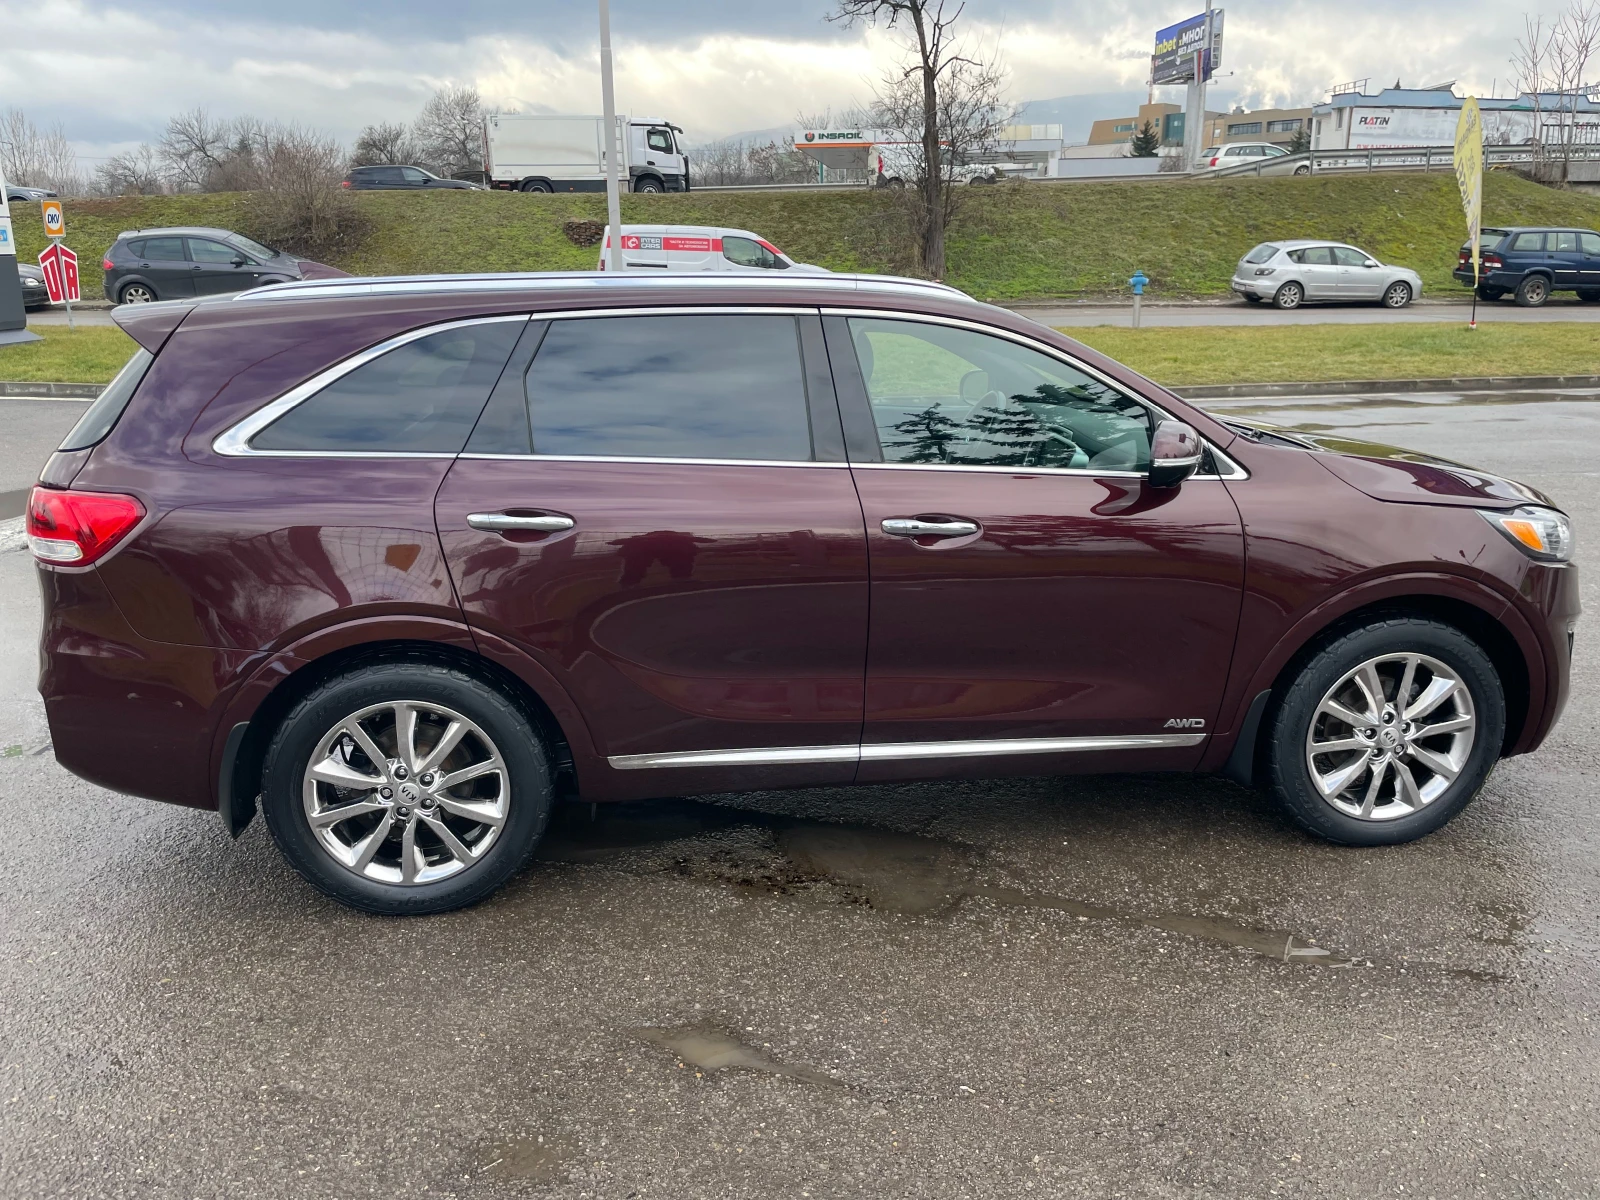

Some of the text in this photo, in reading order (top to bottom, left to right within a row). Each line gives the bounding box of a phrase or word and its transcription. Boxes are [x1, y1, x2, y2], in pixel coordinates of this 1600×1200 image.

[1182, 26, 1204, 46] МНОГ
[48, 214, 60, 224] DKV
[1163, 718, 1206, 728] AWD
[1384, 731, 1396, 744] KIA
[401, 786, 417, 802] KIA
